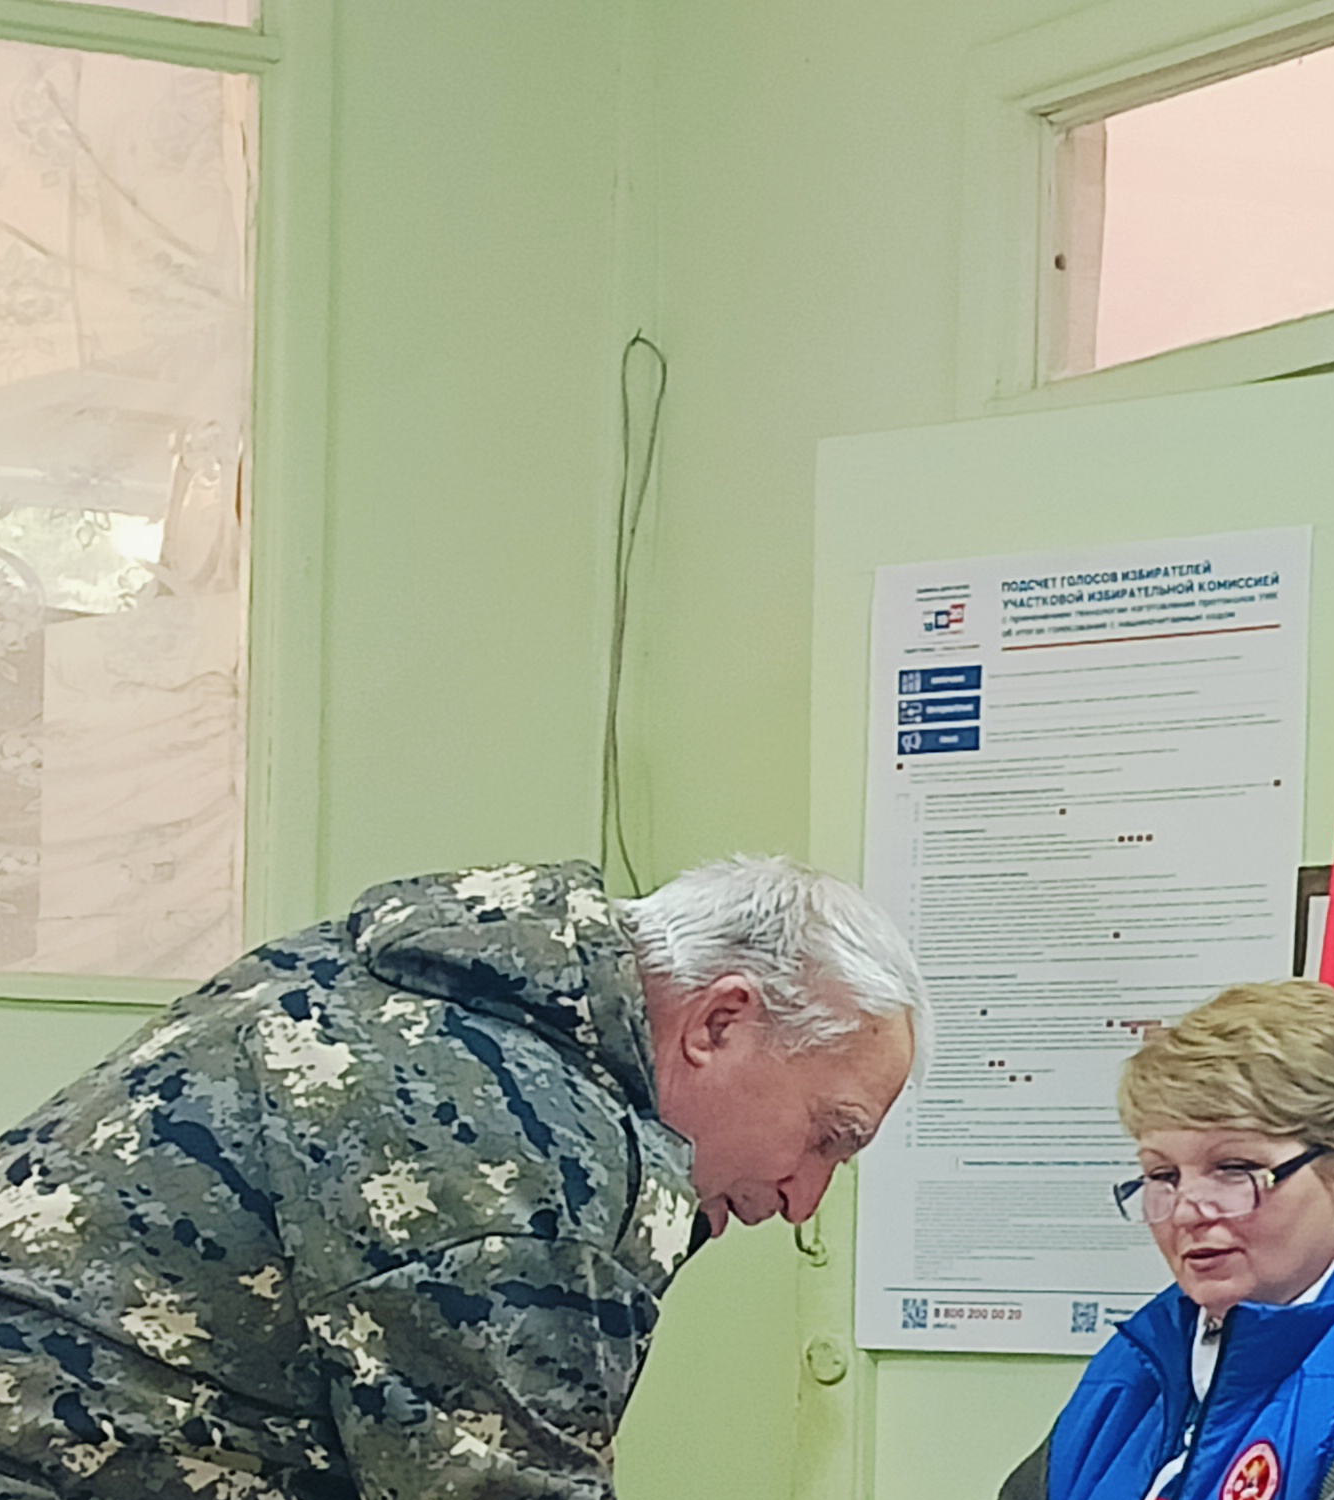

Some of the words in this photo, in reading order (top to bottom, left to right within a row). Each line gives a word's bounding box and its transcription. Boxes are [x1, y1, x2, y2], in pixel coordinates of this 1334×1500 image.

[1001, 576, 1057, 593] ПОДСЧЕТ
[1061, 571, 1118, 588] ГОЛОСОВ
[1121, 559, 1212, 581] ИЗБИРАТЕЛЕЙ
[1002, 589, 1084, 609] УЧАСТКОВОЙ
[1087, 579, 1194, 602] ИЗБИРАТЕЛЬНОЙ
[1198, 571, 1280, 592] КОМИССИЕЙ
